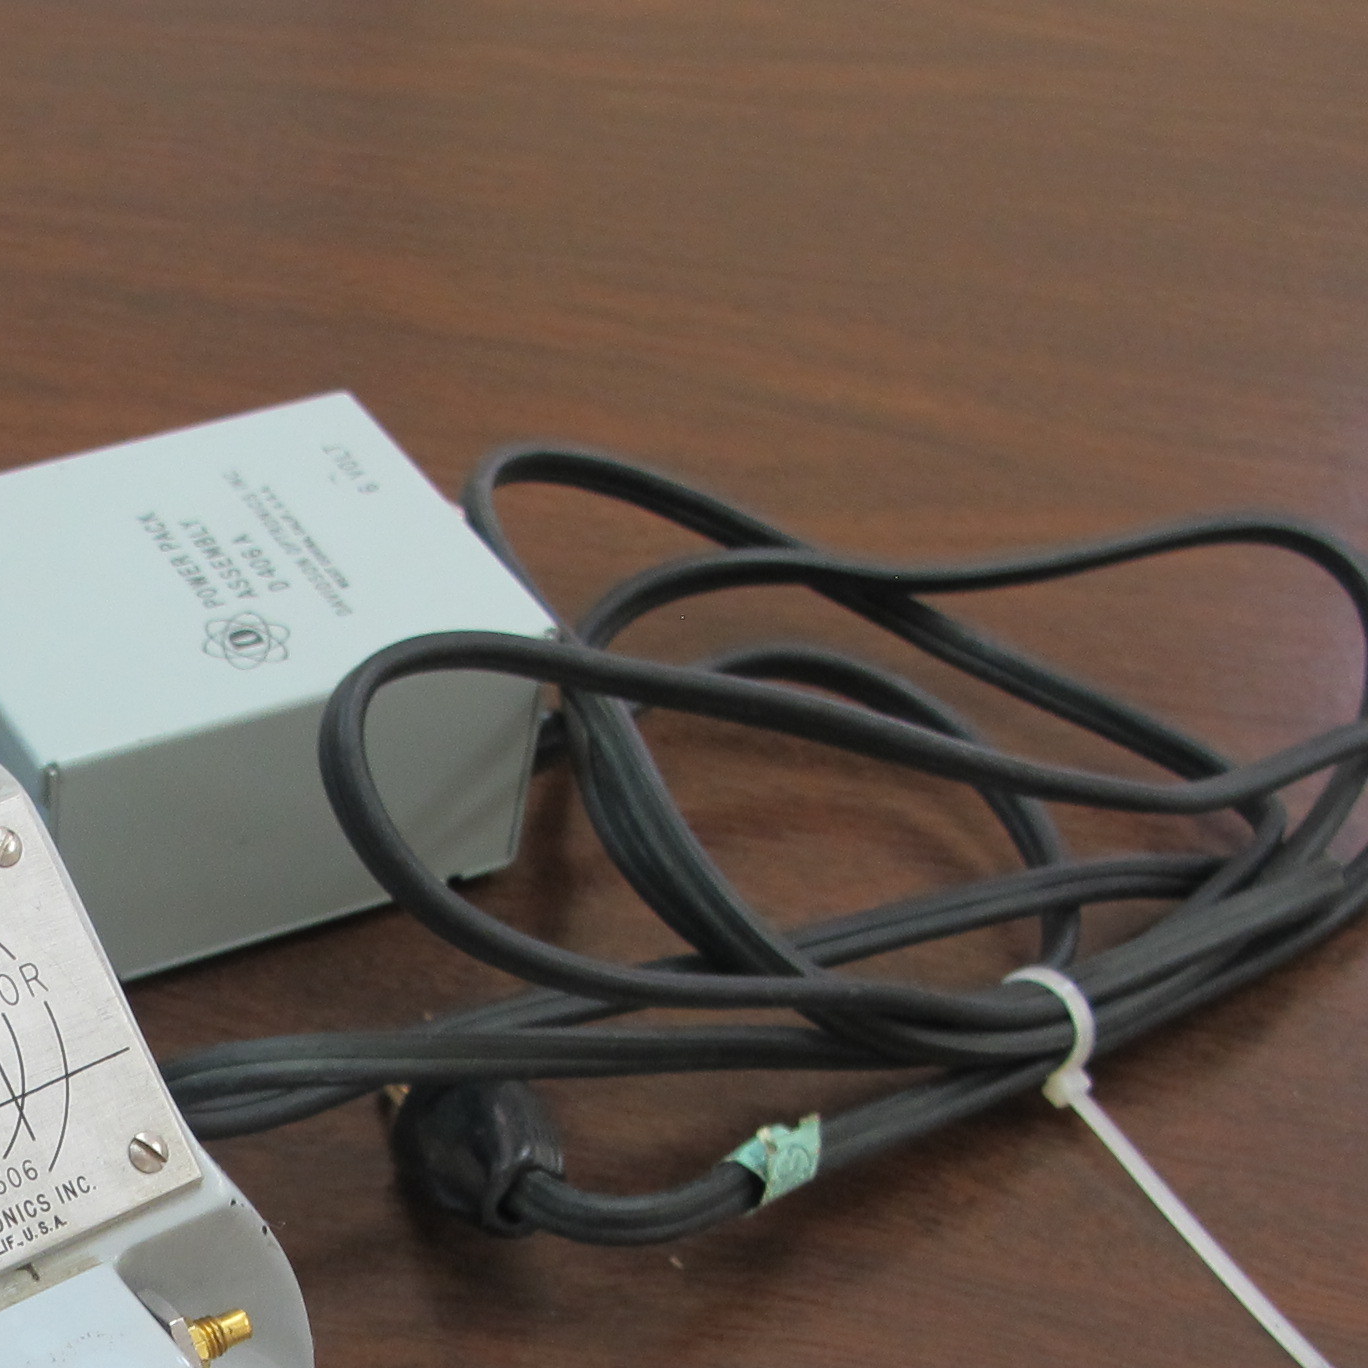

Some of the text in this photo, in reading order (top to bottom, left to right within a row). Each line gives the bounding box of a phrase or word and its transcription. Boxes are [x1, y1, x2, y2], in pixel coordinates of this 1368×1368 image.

[136, 512, 226, 608] POWER PACK
[179, 520, 258, 599] ASSEMBLY
[54, 1175, 98, 1204] INC.
